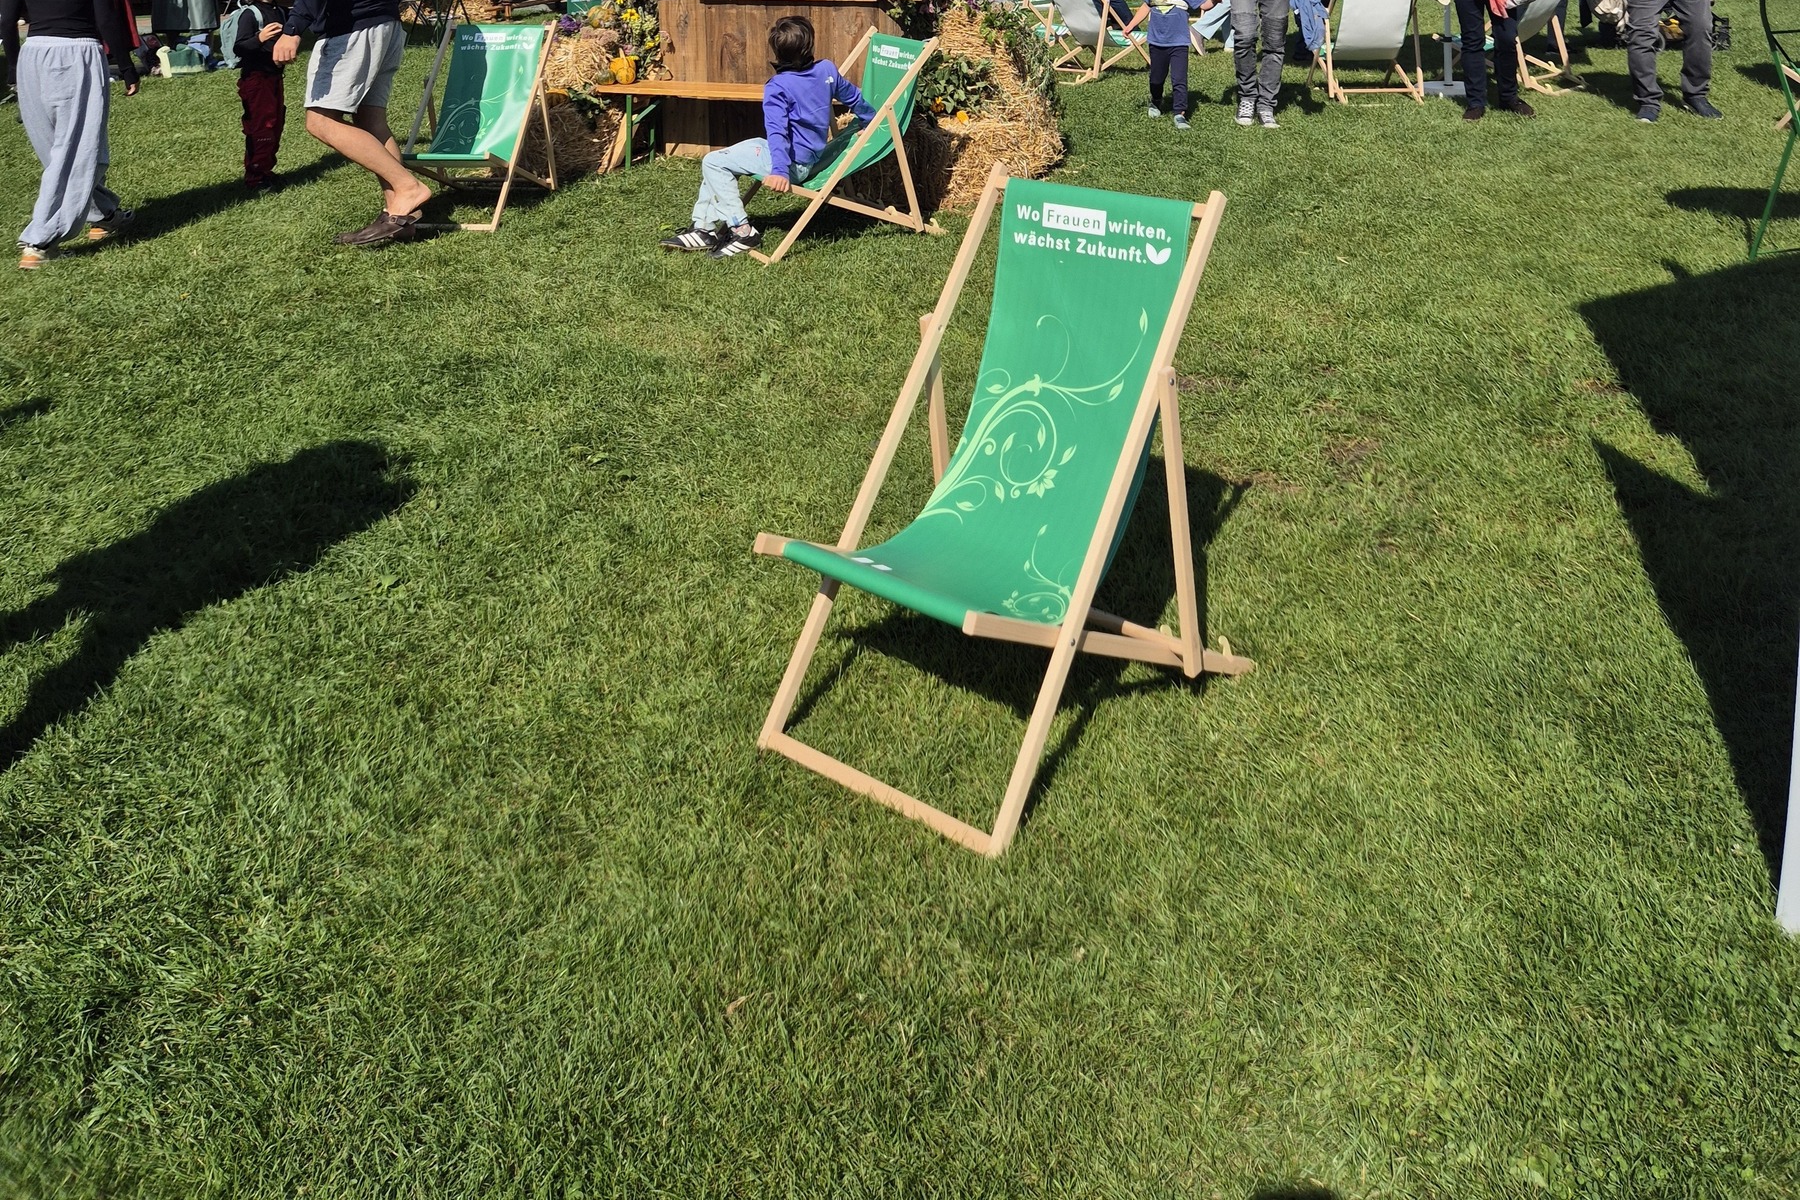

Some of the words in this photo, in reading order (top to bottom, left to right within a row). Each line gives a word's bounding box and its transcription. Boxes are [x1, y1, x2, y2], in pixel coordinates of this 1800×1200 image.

[1016, 204, 1040, 221] Wo
[1047, 209, 1101, 230] Frauen
[1108, 219, 1172, 243] wirken,
[1014, 231, 1071, 251] wächst
[1075, 238, 1147, 264] Zukunft.
